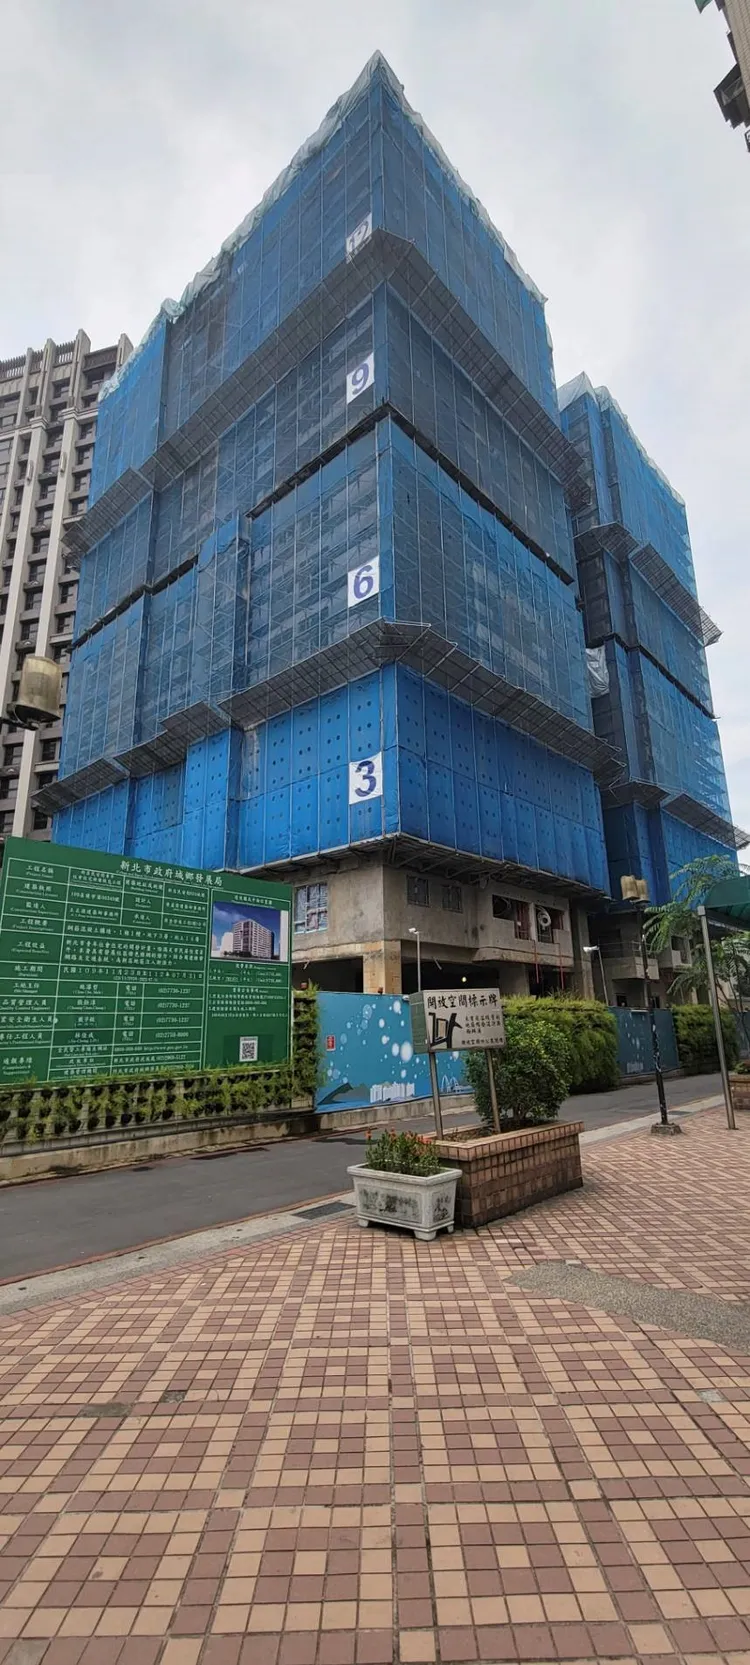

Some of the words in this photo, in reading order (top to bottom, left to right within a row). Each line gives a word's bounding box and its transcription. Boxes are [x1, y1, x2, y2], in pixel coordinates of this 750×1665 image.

[351, 362, 370, 396] 9
[353, 564, 374, 600] 6
[354, 760, 377, 798] 3
[120, 860, 222, 886] 新北市政府城鄉發展局
[427, 994, 498, 1009] 開放空間標示牌
